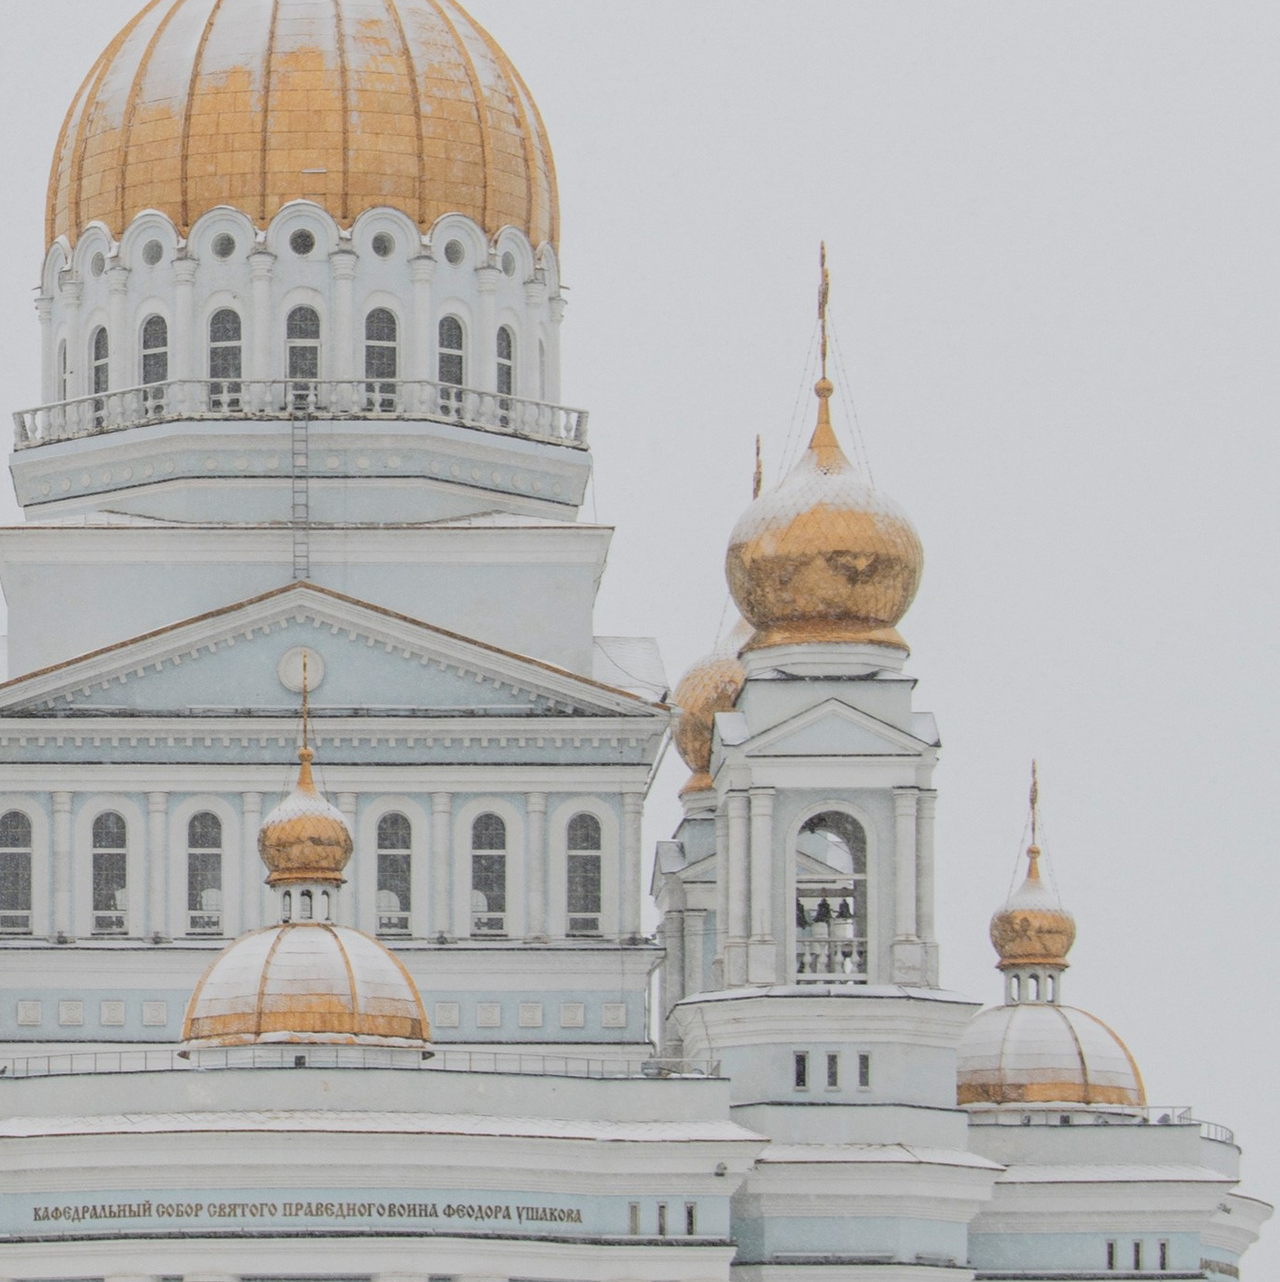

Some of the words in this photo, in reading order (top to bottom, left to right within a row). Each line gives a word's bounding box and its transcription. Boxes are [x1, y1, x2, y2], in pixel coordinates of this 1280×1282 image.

[33, 1201, 153, 1223] КАФЕДРАЛЬНЫЙ
[156, 1203, 203, 1218] СОБОР
[207, 1202, 278, 1218] СВЯТОГО
[282, 1202, 386, 1220] ПРАВЕДНОГО
[387, 1203, 440, 1218] ВОИНА
[442, 1204, 512, 1222] ФЕОДОРА
[516, 1206, 583, 1225] УШАКОВА
